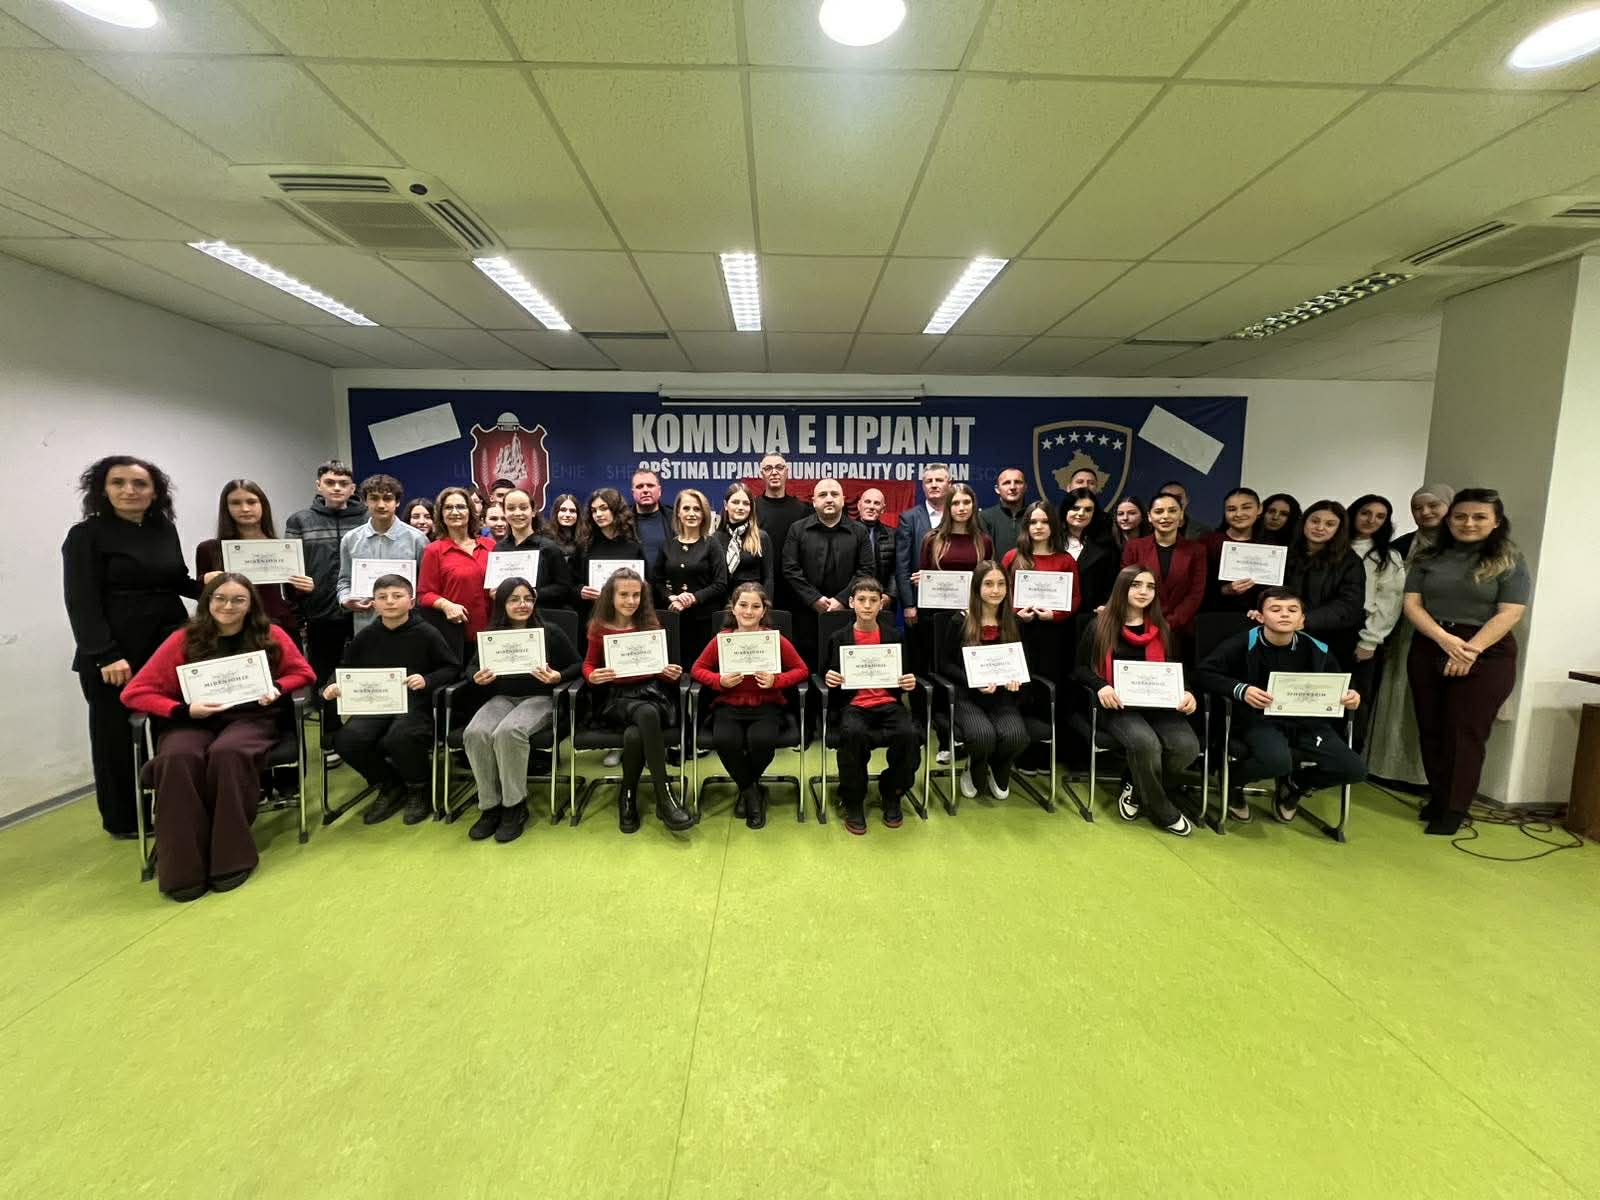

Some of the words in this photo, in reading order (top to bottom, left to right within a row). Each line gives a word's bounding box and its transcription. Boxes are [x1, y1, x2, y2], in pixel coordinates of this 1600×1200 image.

[632, 413, 790, 454] KOMUNA
[799, 415, 817, 454] E
[826, 415, 975, 455] LIPJANIT
[895, 462, 915, 480] OF
[918, 463, 969, 481] LAN
